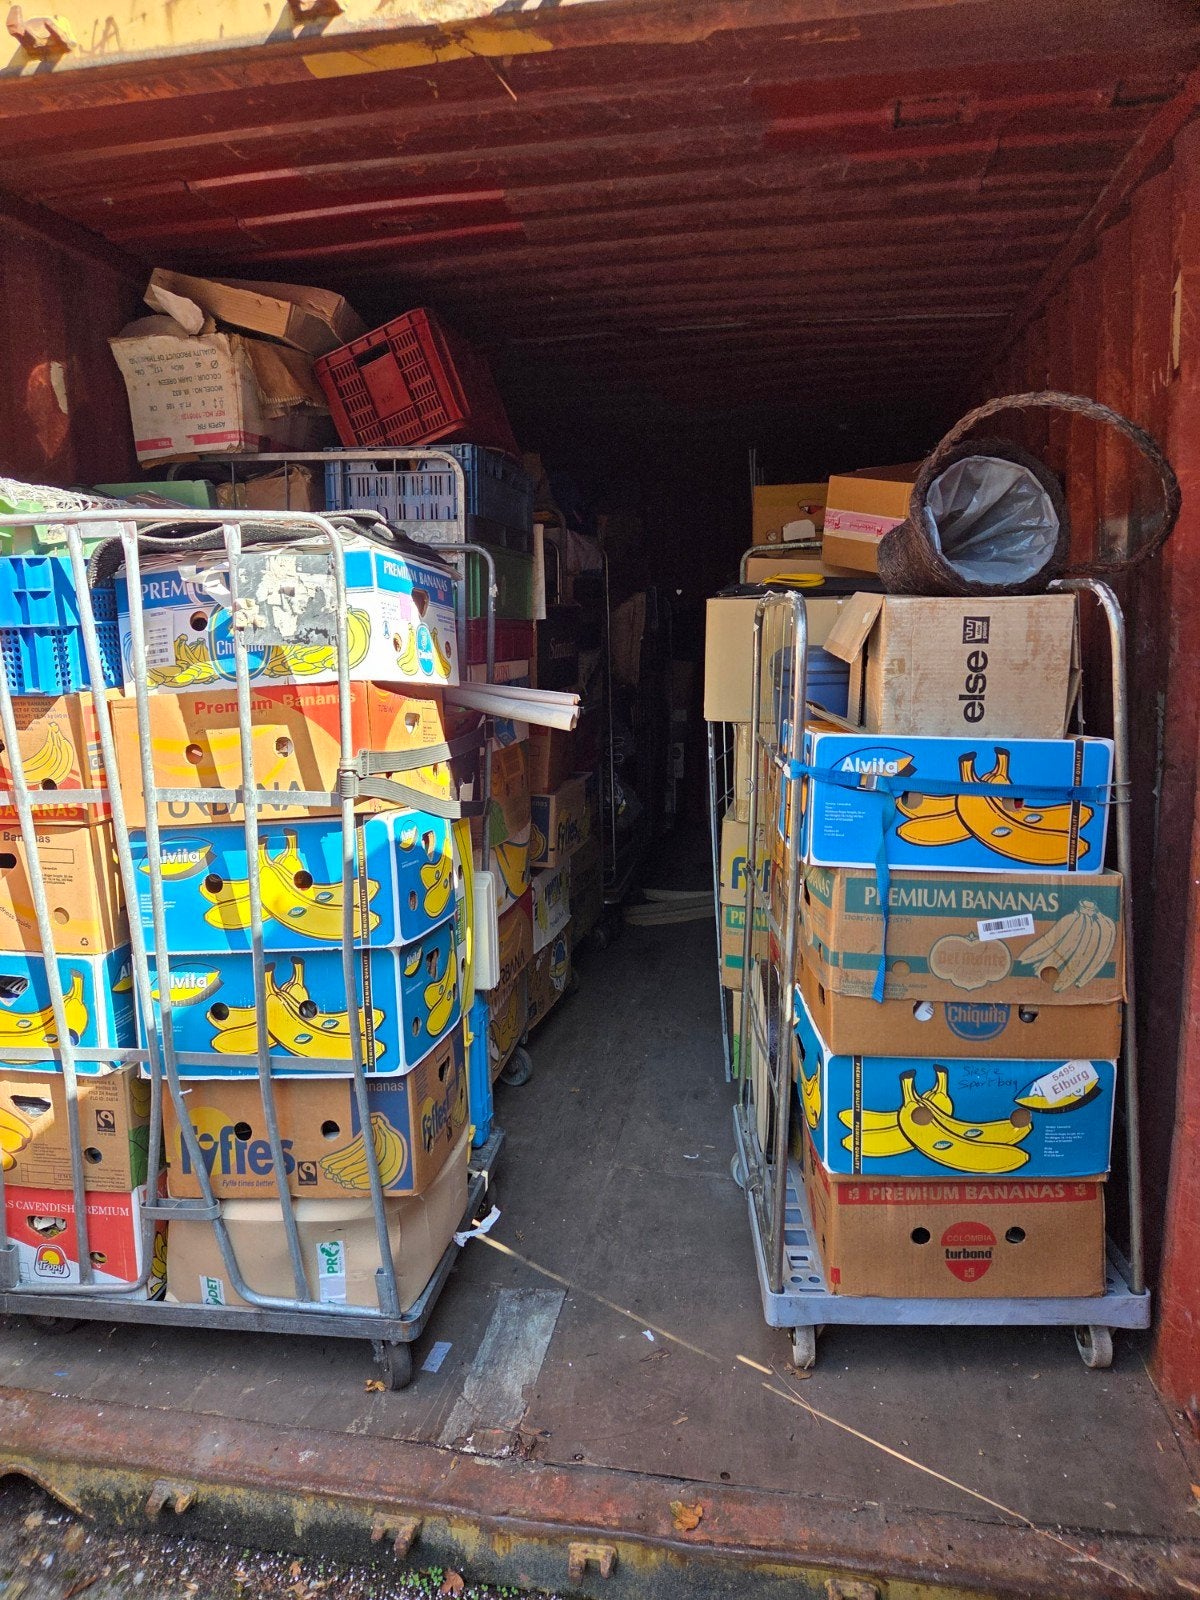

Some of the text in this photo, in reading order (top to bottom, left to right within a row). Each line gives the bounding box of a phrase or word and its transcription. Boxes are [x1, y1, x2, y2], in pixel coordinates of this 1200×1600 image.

[959, 650, 988, 723] else
[194, 694, 356, 715] Premum Banans
[841, 757, 898, 773] Alvita
[160, 849, 200, 864] lvita
[962, 889, 1059, 912] BANANAS
[170, 974, 207, 989] lvita
[947, 1004, 1007, 1028] Chiquita
[1052, 1064, 1075, 1082] 5495
[1051, 1070, 1090, 1095] Elburg
[869, 1184, 1066, 1201] PREMIUM BANANAS
[16, 1201, 74, 1214] CAVENDISH
[87, 1205, 130, 1217] REMIUM
[946, 1233, 993, 1243] COLOMBIA
[945, 1247, 993, 1260] turbana
[38, 1259, 65, 1275] Tropy
